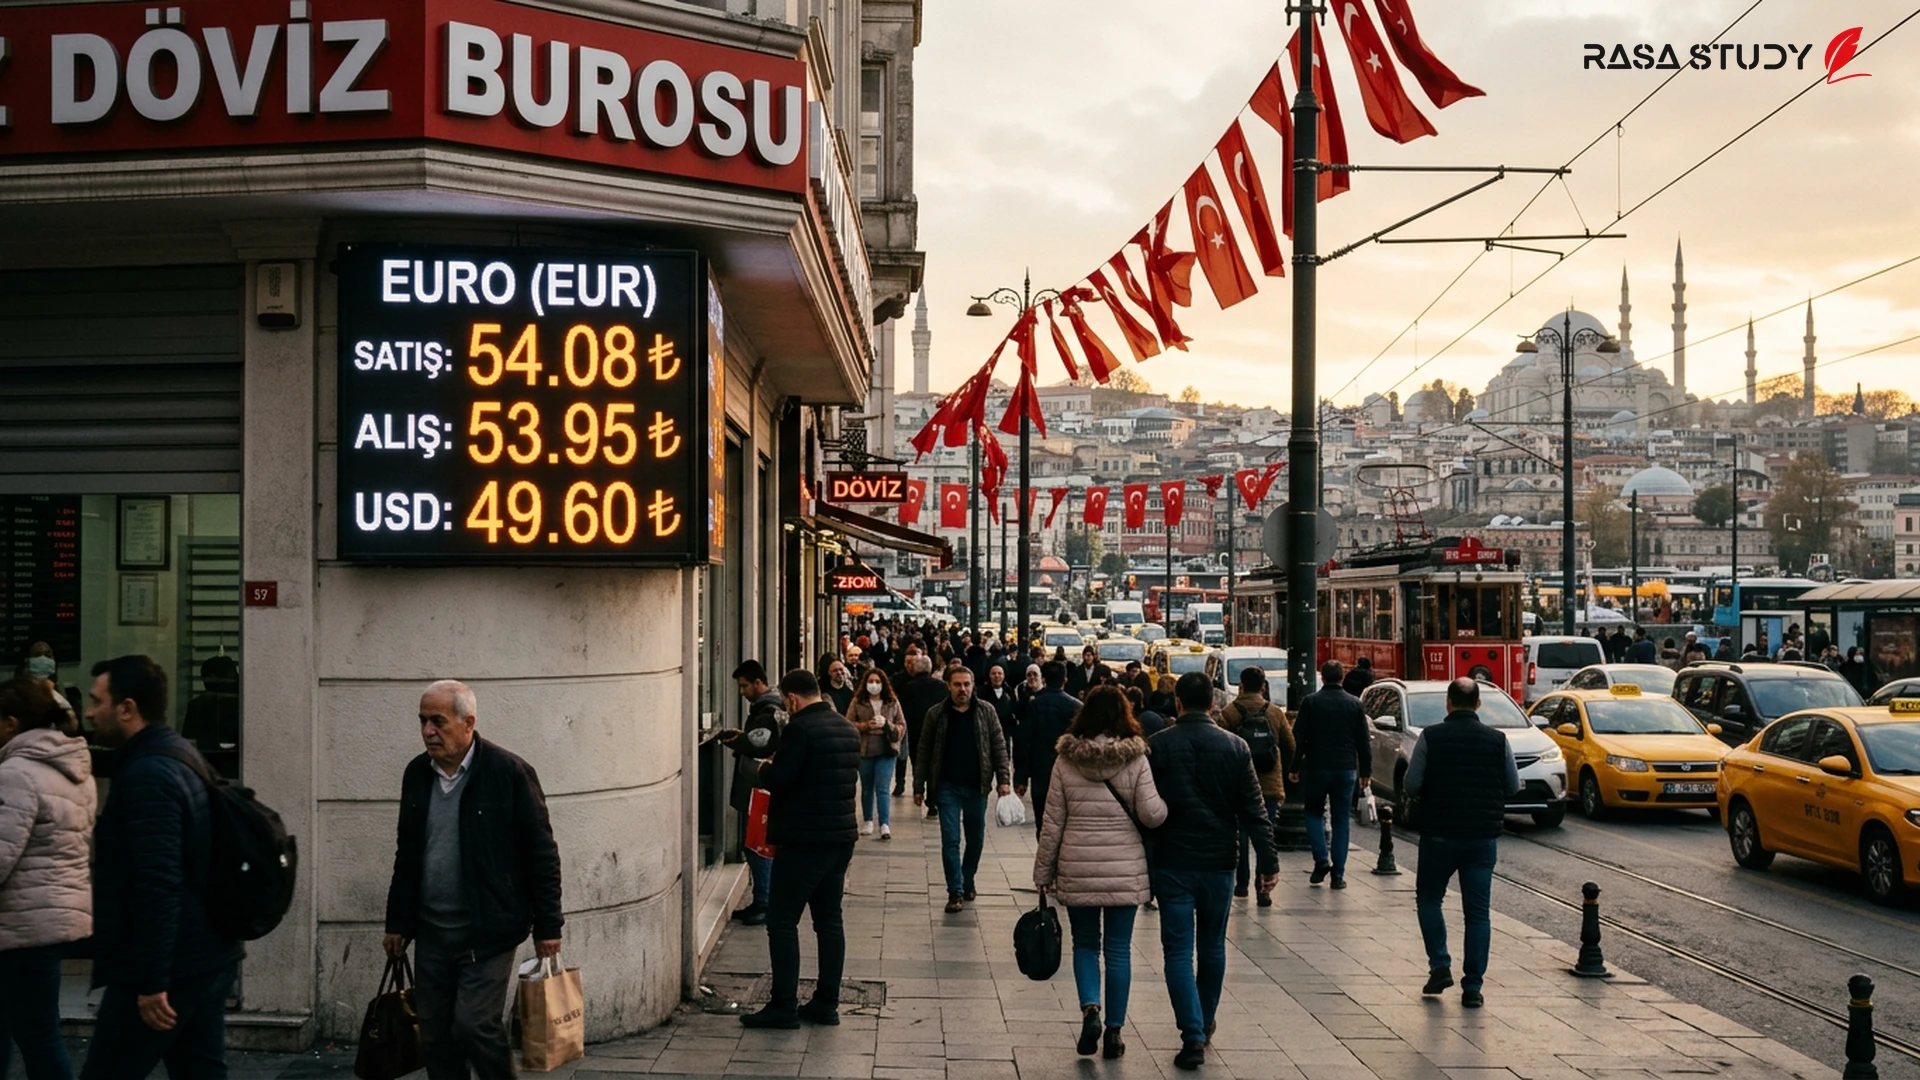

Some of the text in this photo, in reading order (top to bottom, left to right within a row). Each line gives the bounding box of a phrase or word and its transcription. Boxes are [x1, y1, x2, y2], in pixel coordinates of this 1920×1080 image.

[51, 0, 393, 124] DÖVİZ
[444, 20, 802, 166] BUROSU
[382, 259, 658, 318] EURO (EUR)
[354, 340, 453, 380] SATIŞ:
[467, 322, 638, 389] 54.08
[354, 413, 453, 459] ALIŞ:
[467, 400, 638, 466] 53.95
[355, 491, 453, 532] USD:
[466, 480, 638, 546] 49.60
[834, 476, 902, 498] DÖVİZ
